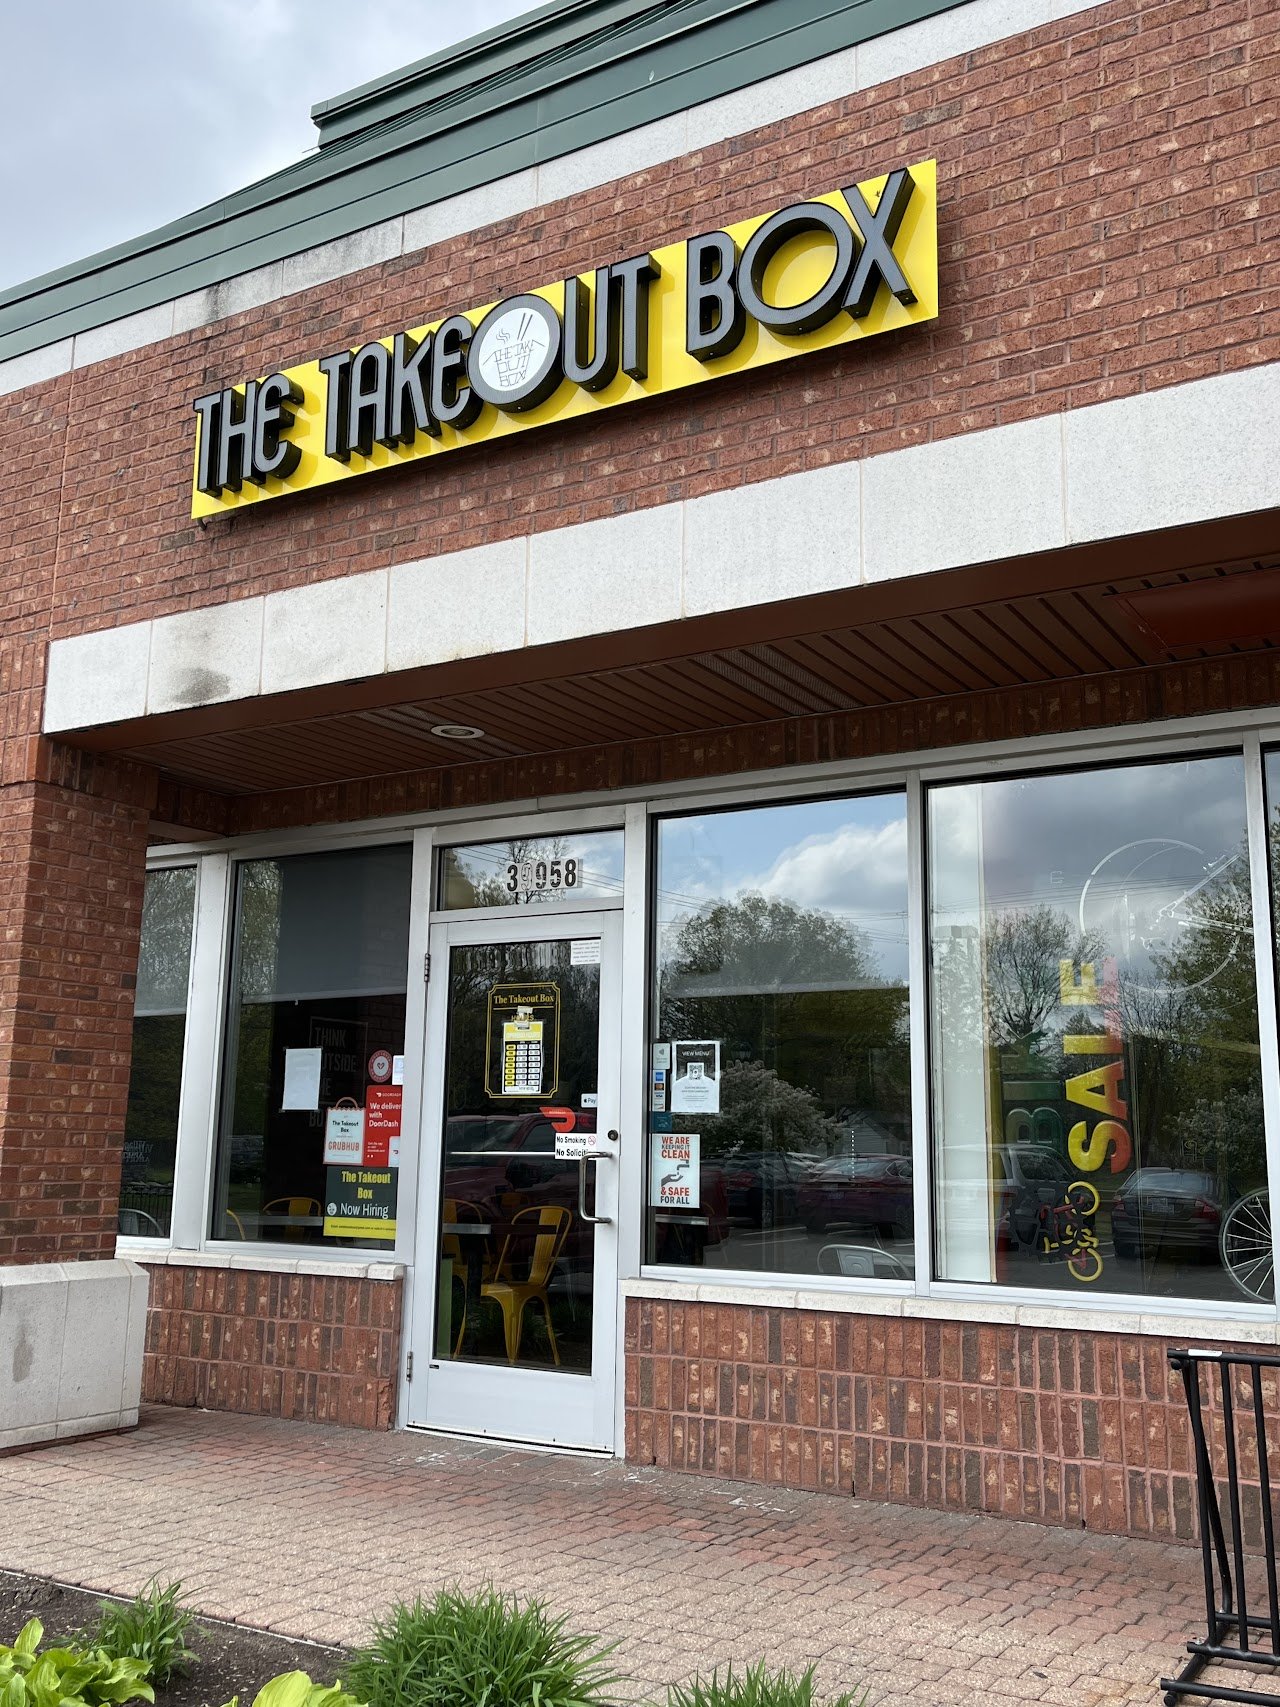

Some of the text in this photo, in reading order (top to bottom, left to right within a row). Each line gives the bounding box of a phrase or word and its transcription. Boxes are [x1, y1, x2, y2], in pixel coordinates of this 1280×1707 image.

[193, 167, 918, 495] THE TAKEOUT BOX
[507, 859, 576, 892] 39958
[493, 993, 555, 1004] The Takeout Box
[315, 1027, 347, 1048] THINK
[321, 1052, 357, 1072] UTSIDE
[1059, 956, 1133, 1174] SALE
[369, 1102, 402, 1110] We deliver
[368, 1120, 399, 1128] DoorDash
[556, 1136, 587, 1145] No Smoking
[661, 1136, 690, 1145] WE ARE
[328, 1141, 360, 1151] GRUBHUB
[556, 1148, 565, 1157] No
[661, 1150, 690, 1159] CLEAN
[341, 1170, 391, 1184] The Takeout
[357, 1187, 373, 1199] Box
[661, 1186, 690, 1196] & SAFE
[660, 1195, 690, 1205] FOR ALL
[340, 1202, 389, 1220] Now Hiring
